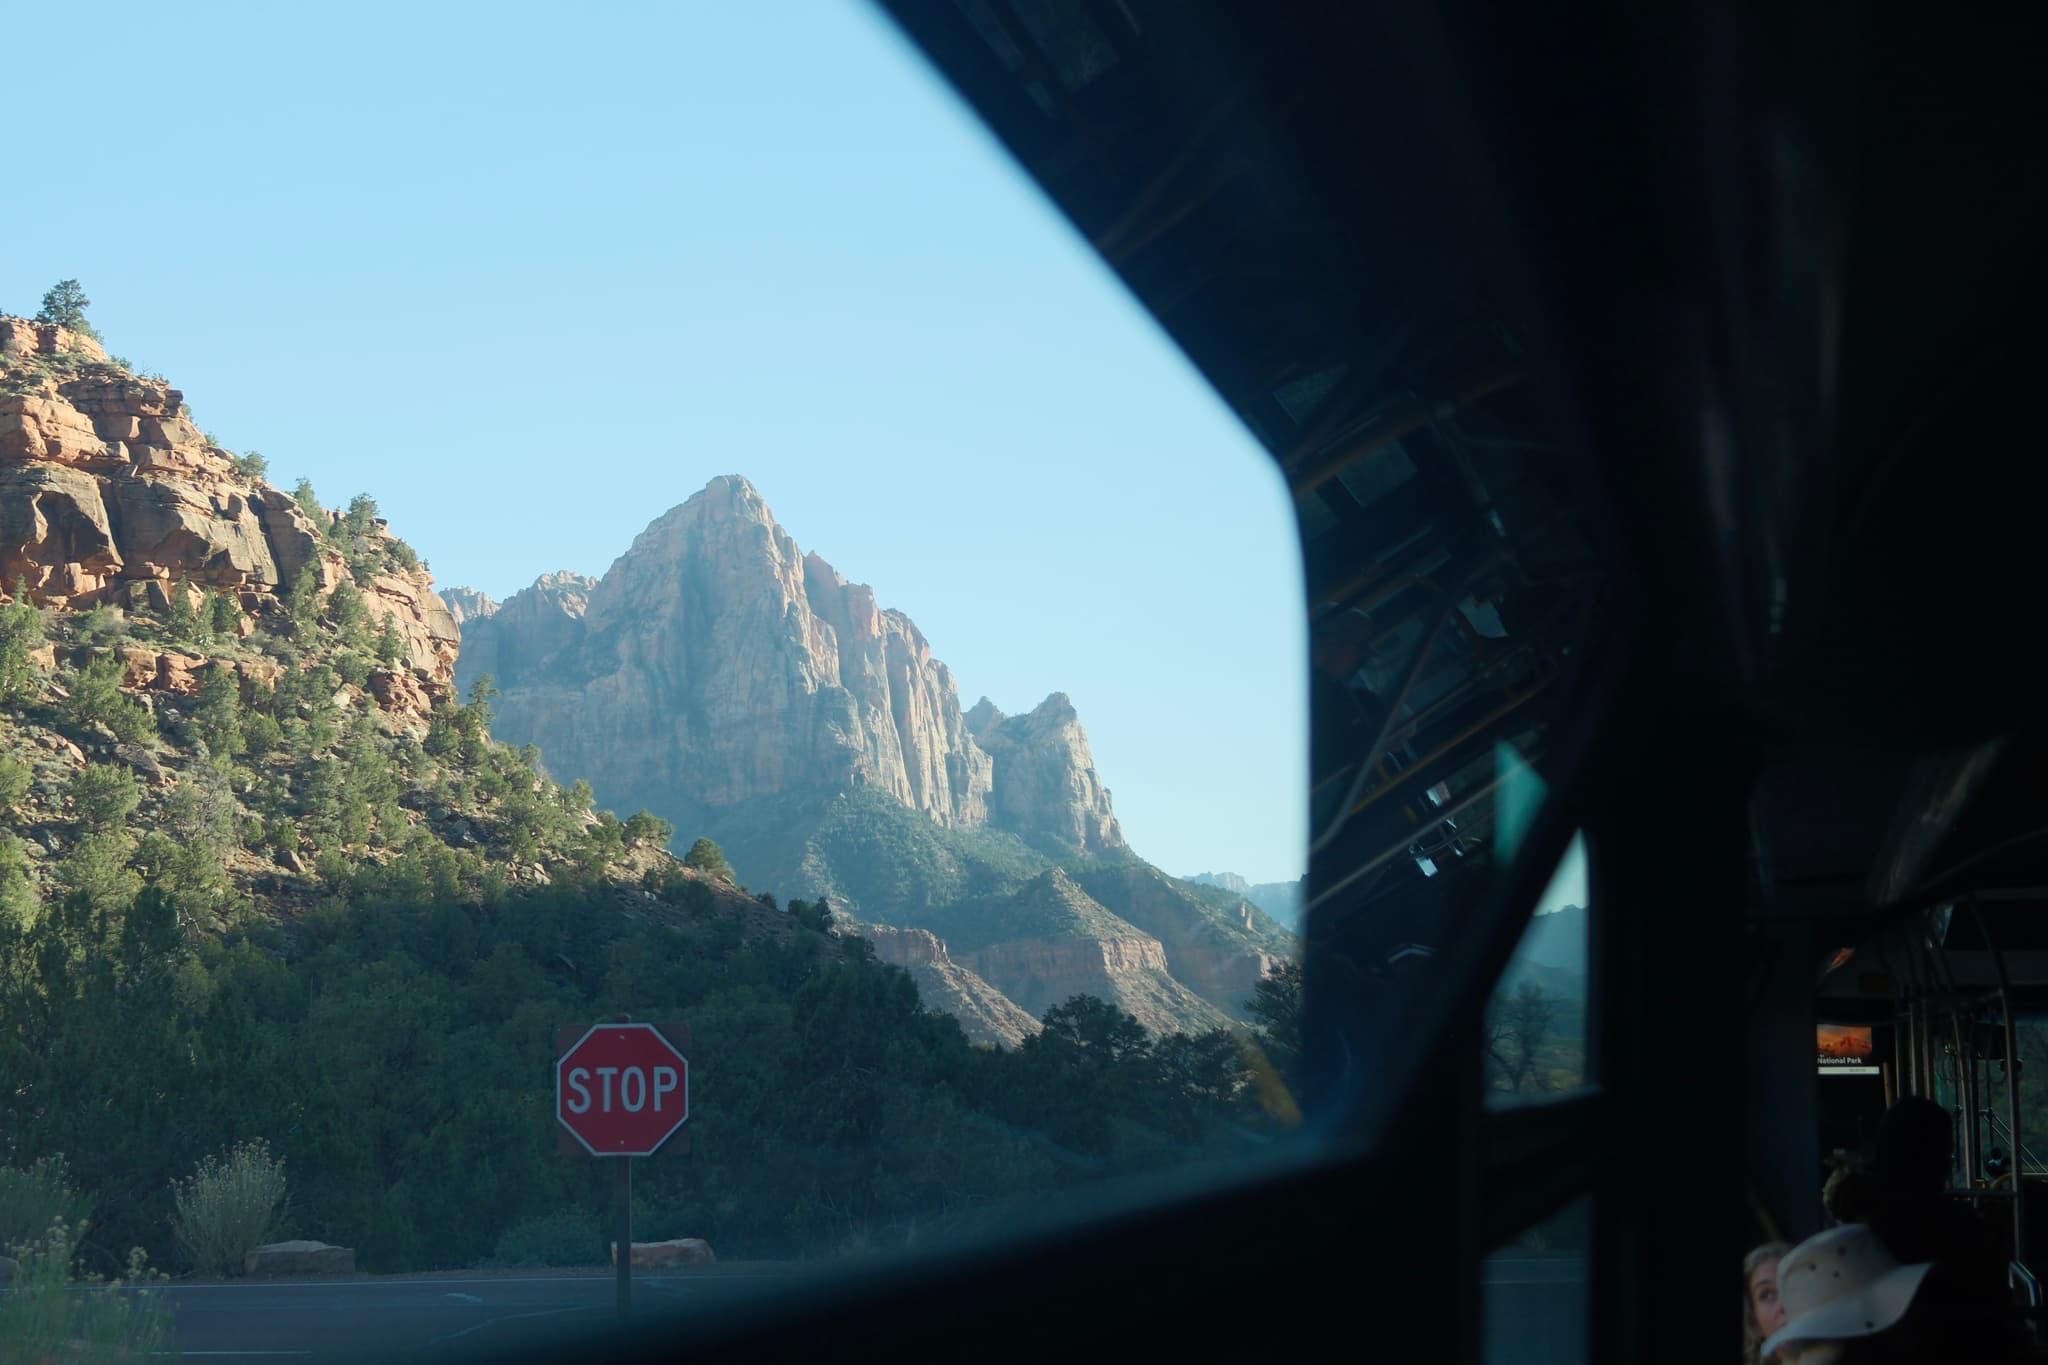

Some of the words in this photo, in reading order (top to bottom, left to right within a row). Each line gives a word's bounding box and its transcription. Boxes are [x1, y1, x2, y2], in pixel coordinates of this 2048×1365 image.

[1817, 1056, 1846, 1064] National
[1847, 1056, 1862, 1064] Park
[567, 1066, 678, 1113] STOP
